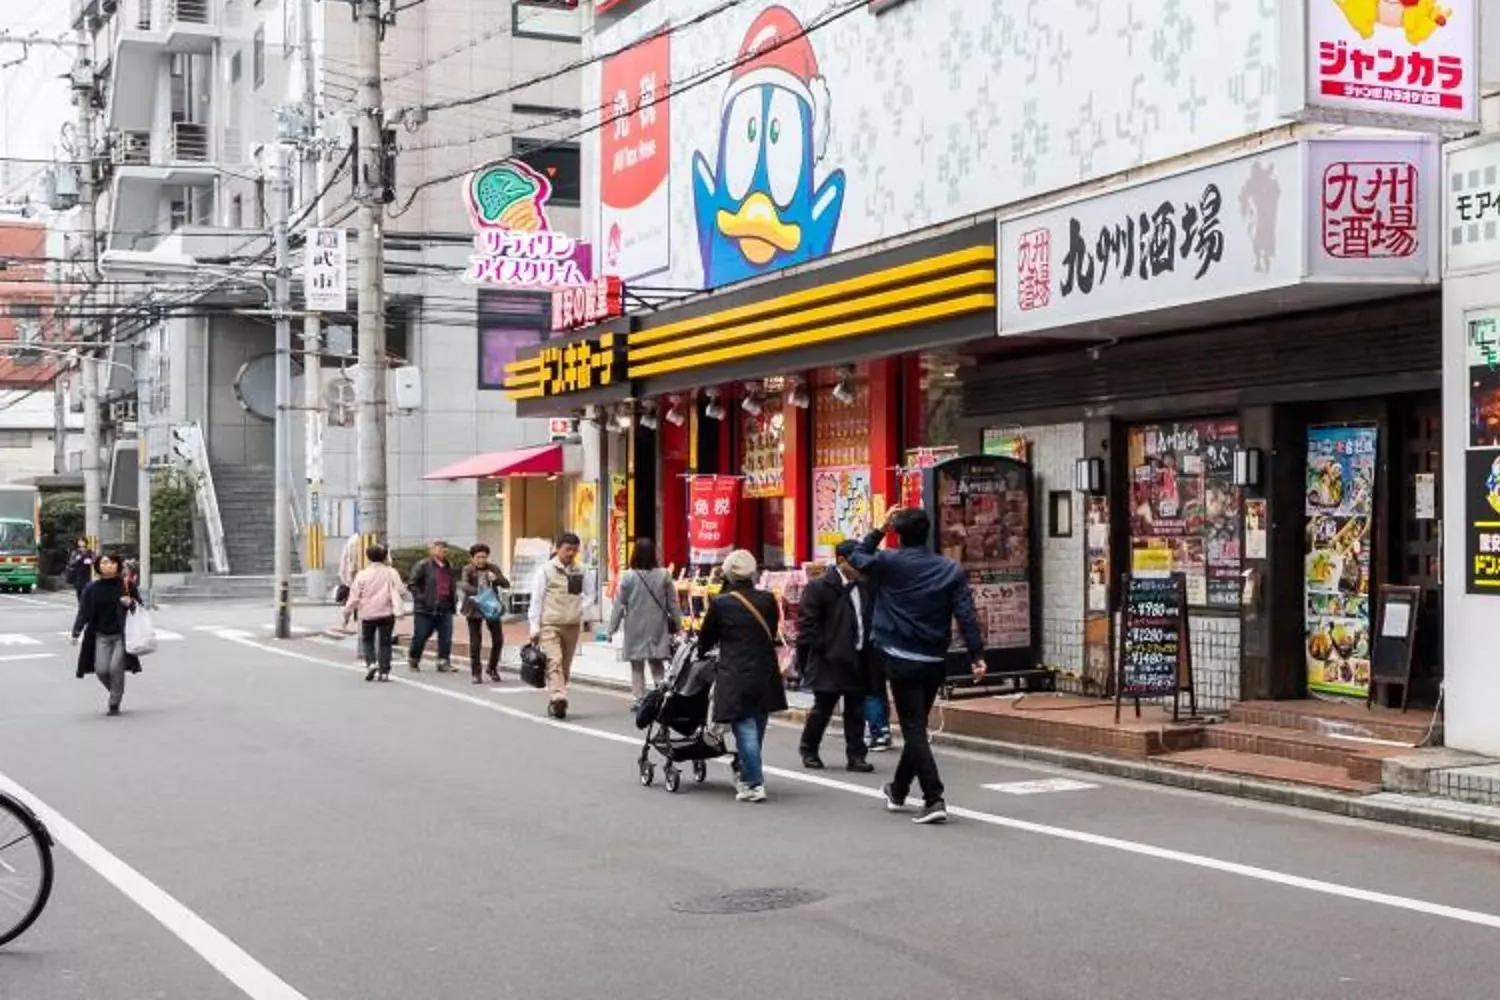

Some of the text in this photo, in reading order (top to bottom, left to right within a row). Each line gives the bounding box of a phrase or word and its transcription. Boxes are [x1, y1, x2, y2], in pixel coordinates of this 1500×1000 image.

[1320, 40, 1462, 90] ジャンカラ
[1061, 184, 1224, 297] 九州酒場
